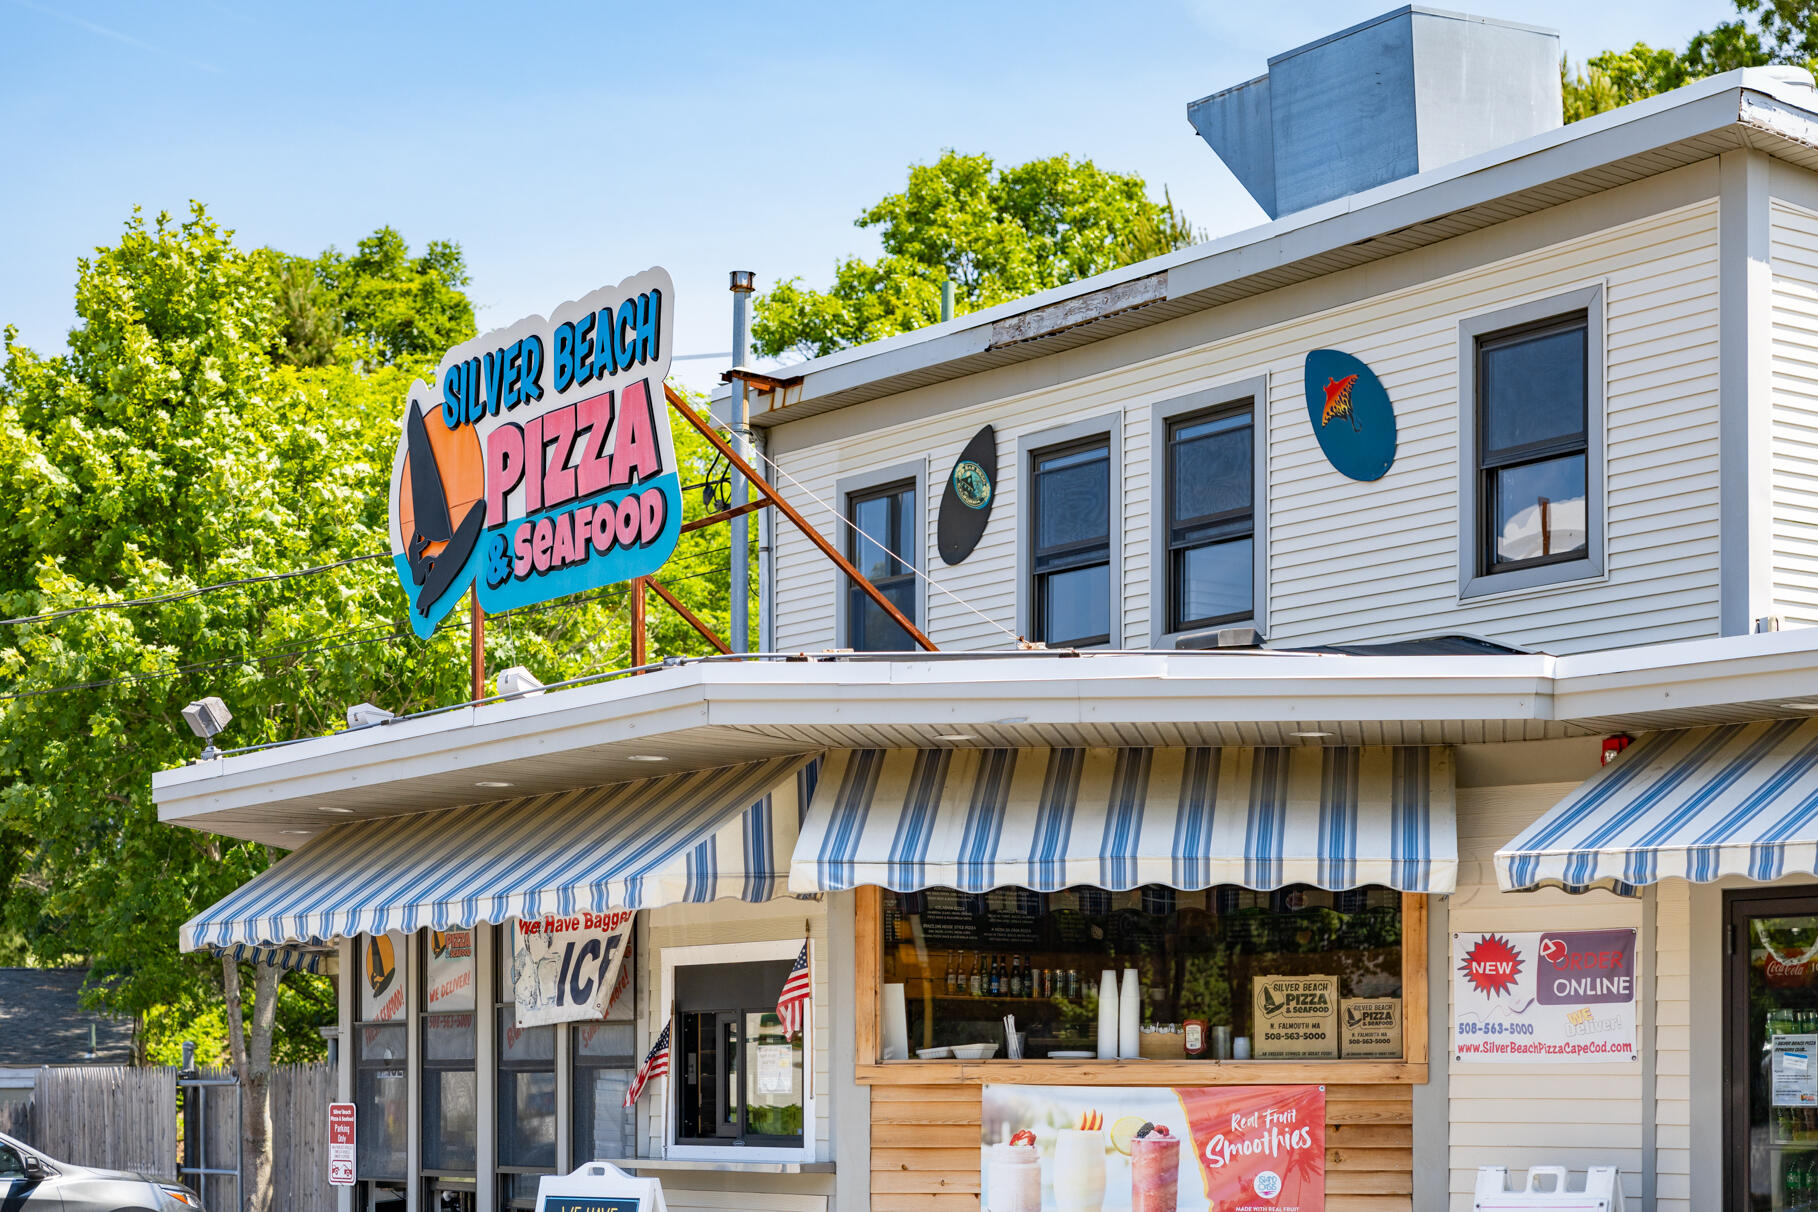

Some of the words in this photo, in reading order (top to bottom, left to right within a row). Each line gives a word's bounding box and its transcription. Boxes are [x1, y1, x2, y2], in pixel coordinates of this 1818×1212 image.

[442, 335, 543, 431] SILVER
[553, 288, 662, 394] BEACH
[487, 378, 663, 531] PIZZA
[486, 534, 513, 589] &
[544, 914, 580, 933] Have
[446, 932, 471, 949] PIZZA
[1472, 962, 1513, 975] NEW
[1553, 951, 1624, 971] ORDER
[430, 984, 440, 1004] WE
[440, 970, 471, 999] DELIVER!
[1273, 983, 1300, 992] SILVER
[1303, 983, 1328, 992] BEACH
[1554, 977, 1630, 997] ONLINE
[1285, 993, 1328, 1006] PIZZA
[1362, 1012, 1392, 1021] PIZZA
[1565, 1014, 1622, 1037] Deliver!
[1567, 1008, 1594, 1026] WE
[1265, 1032, 1326, 1040] 508-563-5000
[1458, 1022, 1534, 1035] 508-563-5000
[1458, 1041, 1632, 1056] www.SilverBeachPizzaCapeCod.com
[1232, 1112, 1258, 1132] Real
[1262, 1108, 1296, 1129] Fruit
[334, 1124, 350, 1136] Parking
[338, 1134, 347, 1144] Only
[1205, 1127, 1311, 1168] Smoothies
